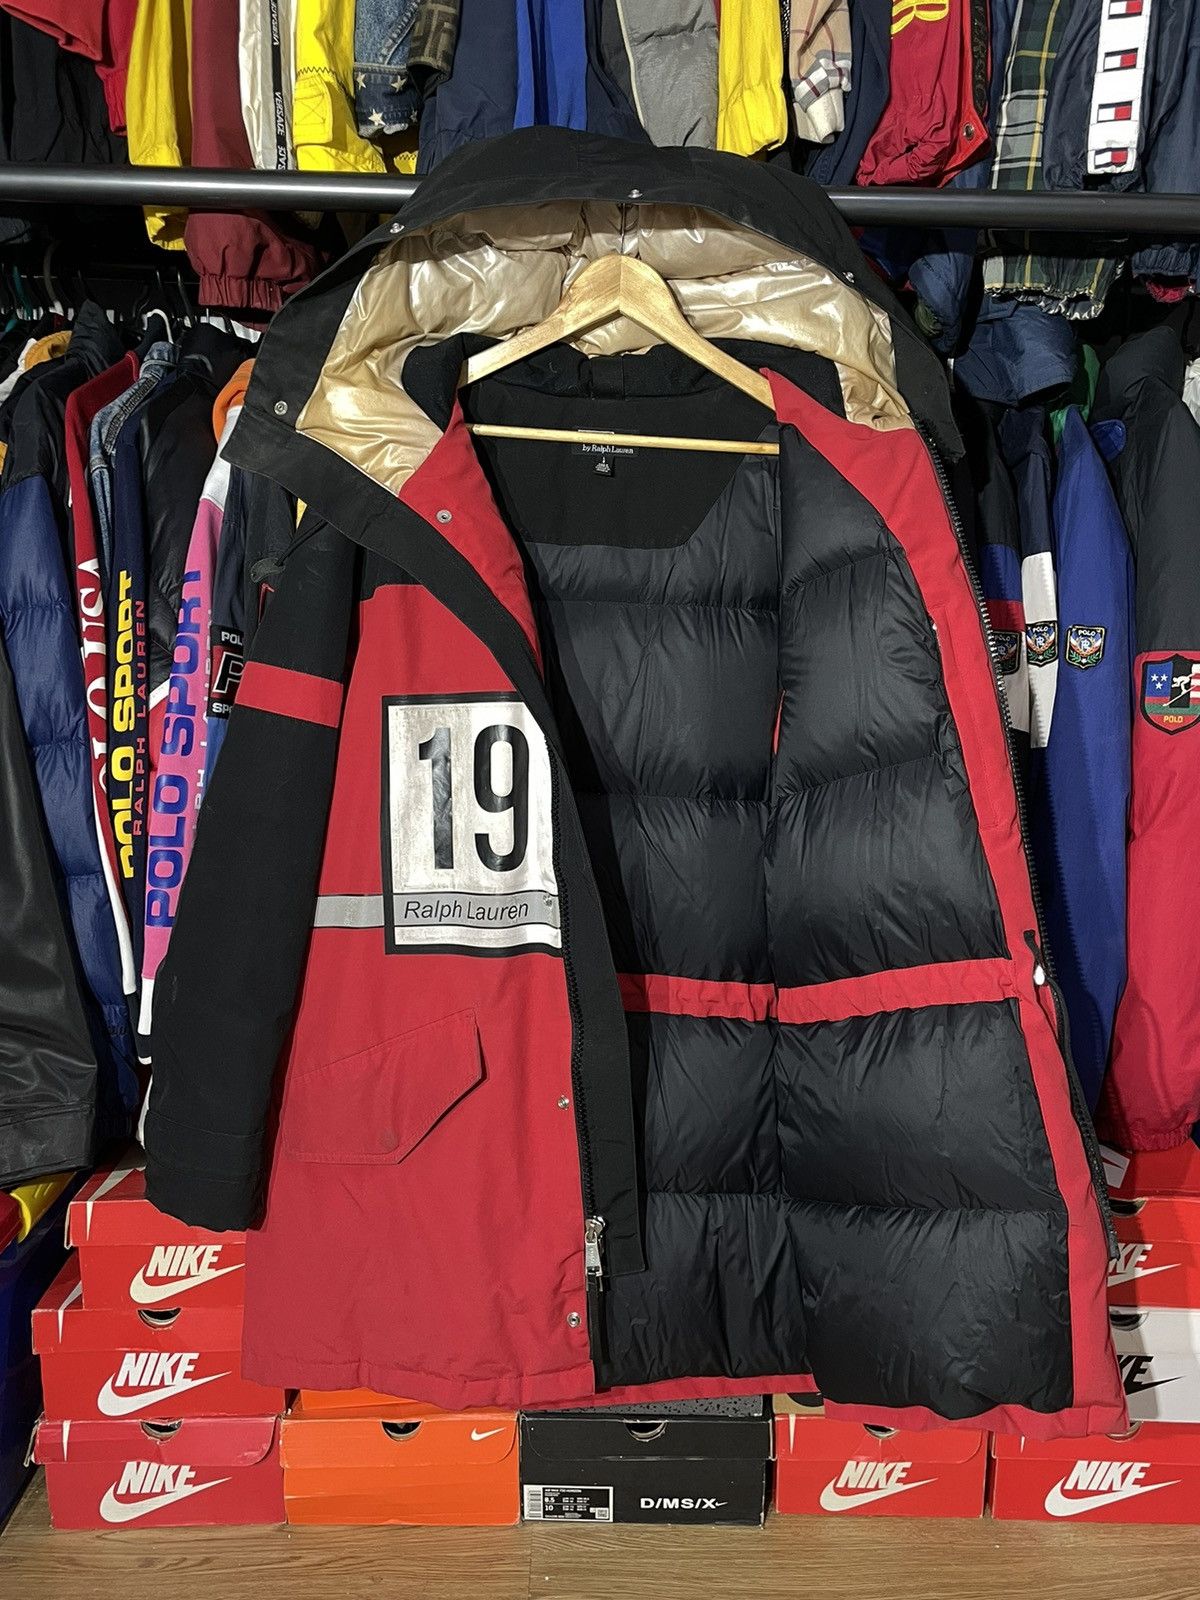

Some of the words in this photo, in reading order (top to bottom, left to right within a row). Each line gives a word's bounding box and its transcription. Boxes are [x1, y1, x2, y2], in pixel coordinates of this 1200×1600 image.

[274, 91, 285, 136] VERSACE
[277, 145, 286, 170] SACE
[582, 444, 591, 452] by
[591, 444, 611, 454] Ralph
[612, 445, 634, 454] Lauren
[221, 631, 243, 647] POL
[135, 601, 146, 719] LAUREN
[1163, 715, 1184, 724] POLO
[133, 735, 145, 836] RALPH
[418, 724, 530, 872] 19
[145, 773, 188, 928] POLO
[404, 900, 463, 922] Ralph
[466, 901, 529, 920] Lauren
[146, 1244, 224, 1277] NIKE
[1108, 1243, 1153, 1274] KE
[114, 1352, 200, 1387] NIKE
[116, 1461, 197, 1494] NIKE
[835, 1460, 913, 1490] NIKE
[1062, 1460, 1152, 1491] NIKE
[640, 1497, 717, 1510] D/MS/X
